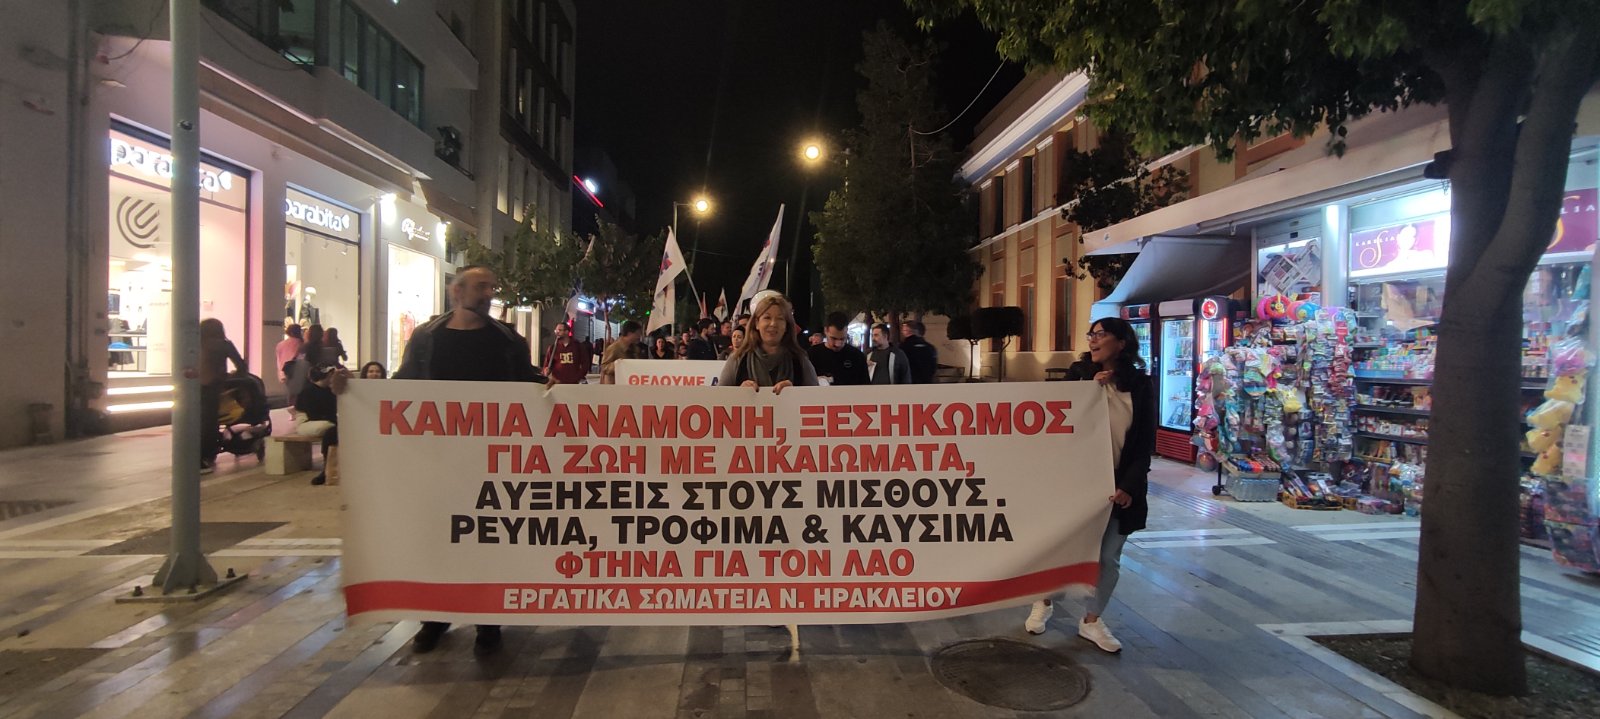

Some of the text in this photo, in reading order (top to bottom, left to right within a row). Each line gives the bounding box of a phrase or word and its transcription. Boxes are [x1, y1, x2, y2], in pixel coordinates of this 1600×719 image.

[110, 138, 220, 192] paraa
[381, 401, 1074, 445] ΚΑΜΙΑ ΑΝΑΜΟΝΗ, ΞΕΣΗΚΩΜΟΣ
[488, 443, 974, 477] ΓΙΑ ΖΩΗ ΜΕ ΔΙΚΑΙΩΜΑΤΑ,
[476, 481, 669, 510] ΑΥΞΗΣΕΙΣ
[682, 481, 803, 510] ΣΤΟΥΣ
[451, 514, 1013, 550] ΡΕΥΜΑ, ΤΡΟΦΙΜΑ & ΚΑΥΣΙΜΑ
[555, 549, 913, 578] ΦΤΗΝΑ ΓΙΑ ΤΟΝ ΛΑΟ
[504, 587, 963, 610] ΕΡΓΑΤΙΚΑ ΣΩΜΑΤΕΙΑ Ν. ΗΡΑΚΛΕΙΟΥ
